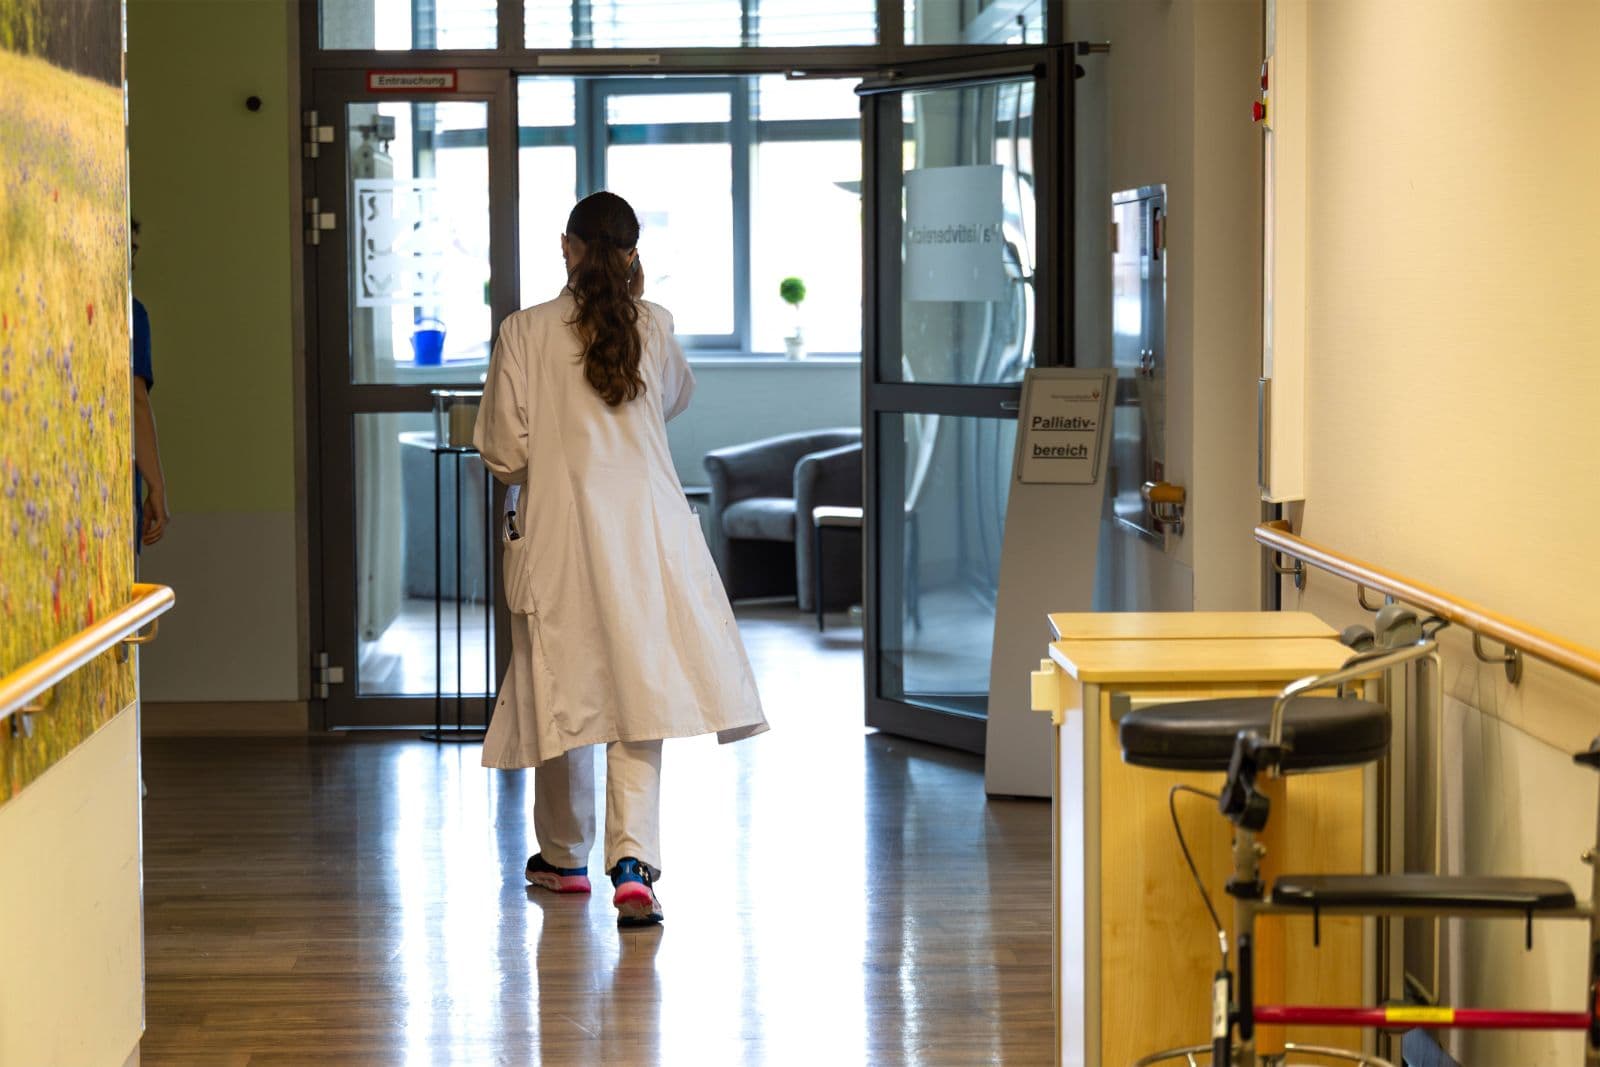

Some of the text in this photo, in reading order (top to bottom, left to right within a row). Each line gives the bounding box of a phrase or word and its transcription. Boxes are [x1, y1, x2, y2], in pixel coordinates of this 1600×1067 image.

[378, 76, 446, 87] Entrauchung
[1031, 415, 1096, 429] Palliativ-
[1033, 443, 1088, 457] bereich
